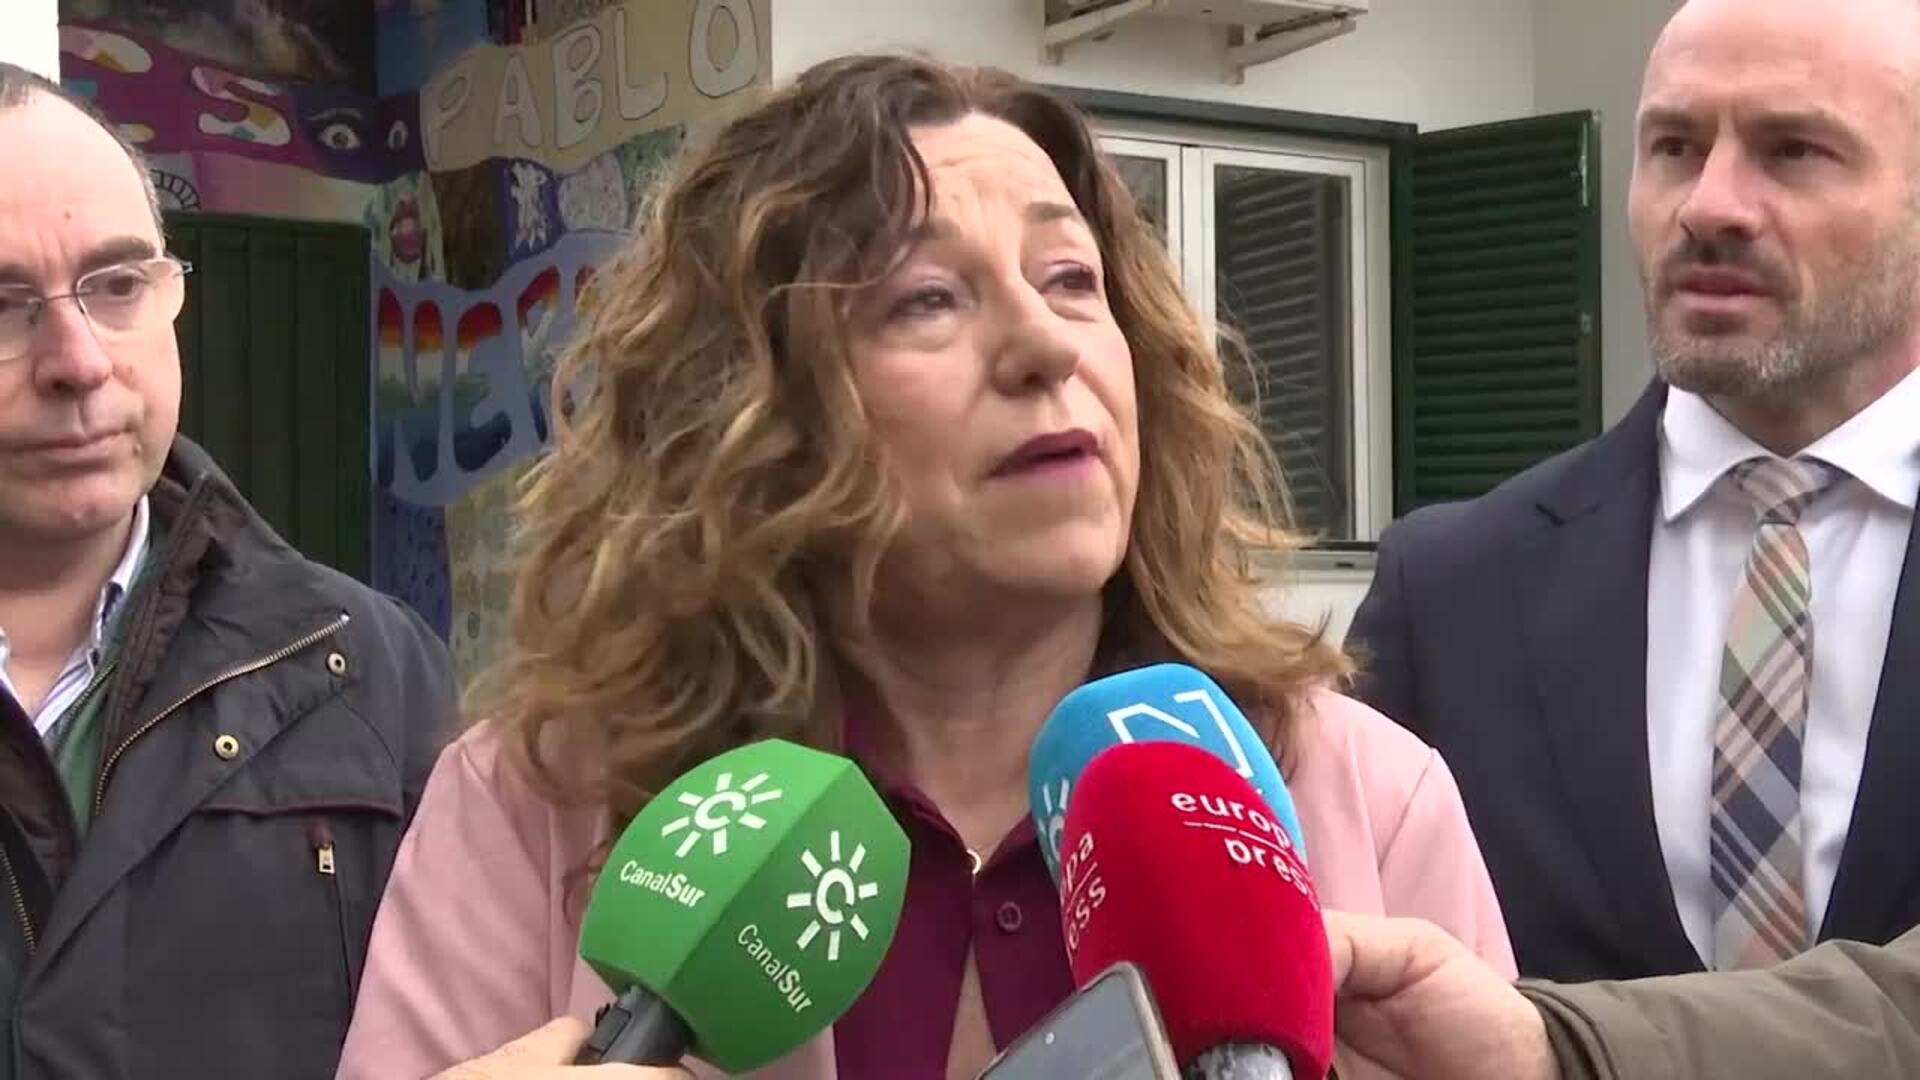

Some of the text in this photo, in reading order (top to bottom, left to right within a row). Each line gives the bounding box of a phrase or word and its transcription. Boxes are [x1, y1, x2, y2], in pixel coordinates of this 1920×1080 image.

[421, 0, 758, 170] PABLO
[1171, 792, 1303, 861] europ
[619, 860, 705, 908] CanalSur
[1223, 837, 1319, 912] pres
[737, 923, 813, 1013] CanalSur
